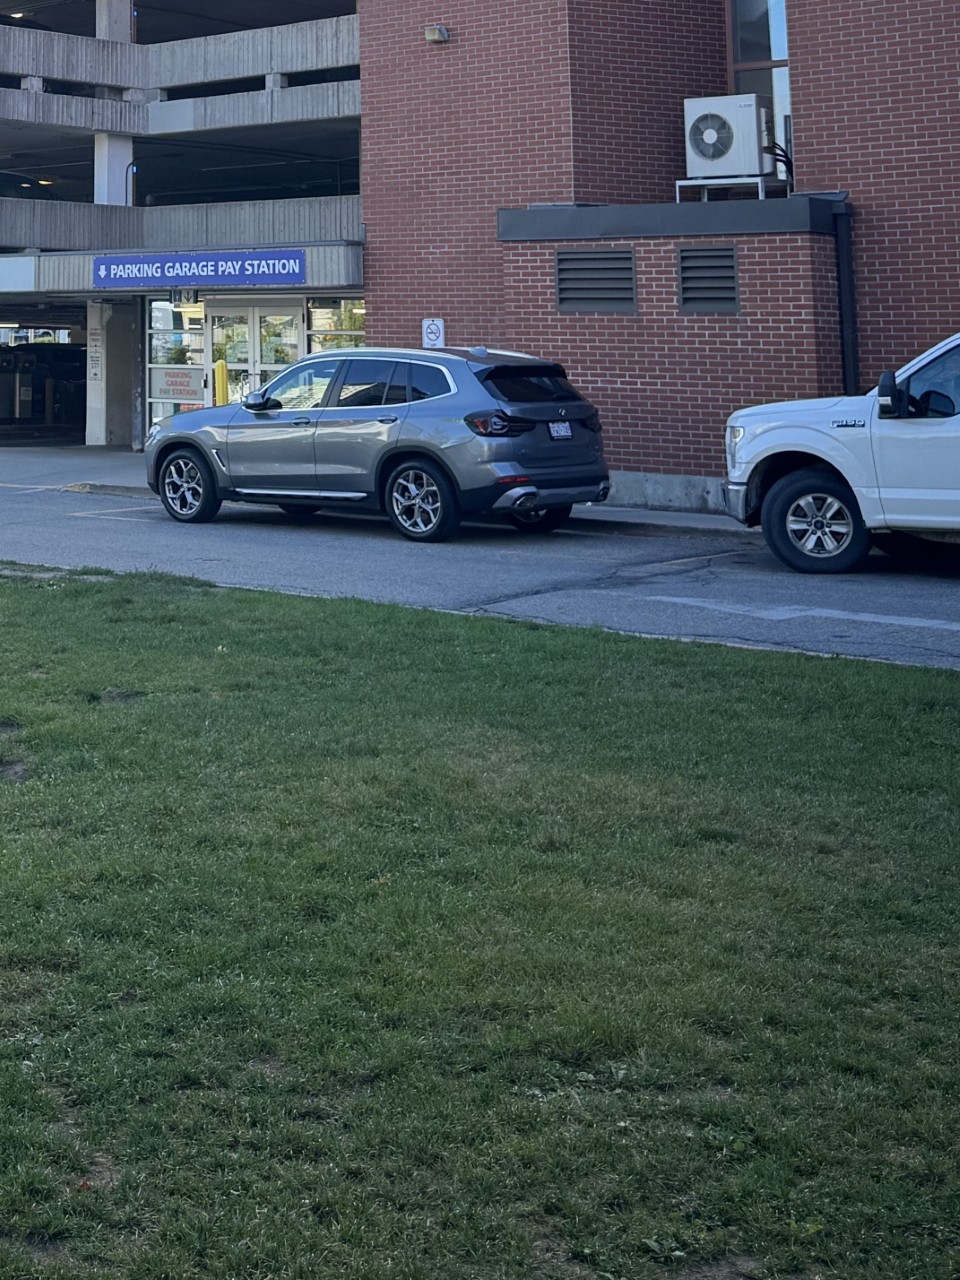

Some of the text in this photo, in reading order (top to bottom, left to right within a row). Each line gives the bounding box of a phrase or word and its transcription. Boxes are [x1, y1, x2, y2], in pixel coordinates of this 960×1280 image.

[110, 259, 300, 278] PARKING GARAGE PAY STATION
[164, 371, 192, 379] PARKING
[165, 379, 191, 387] GARAGE
[171, 388, 198, 396] STATION
